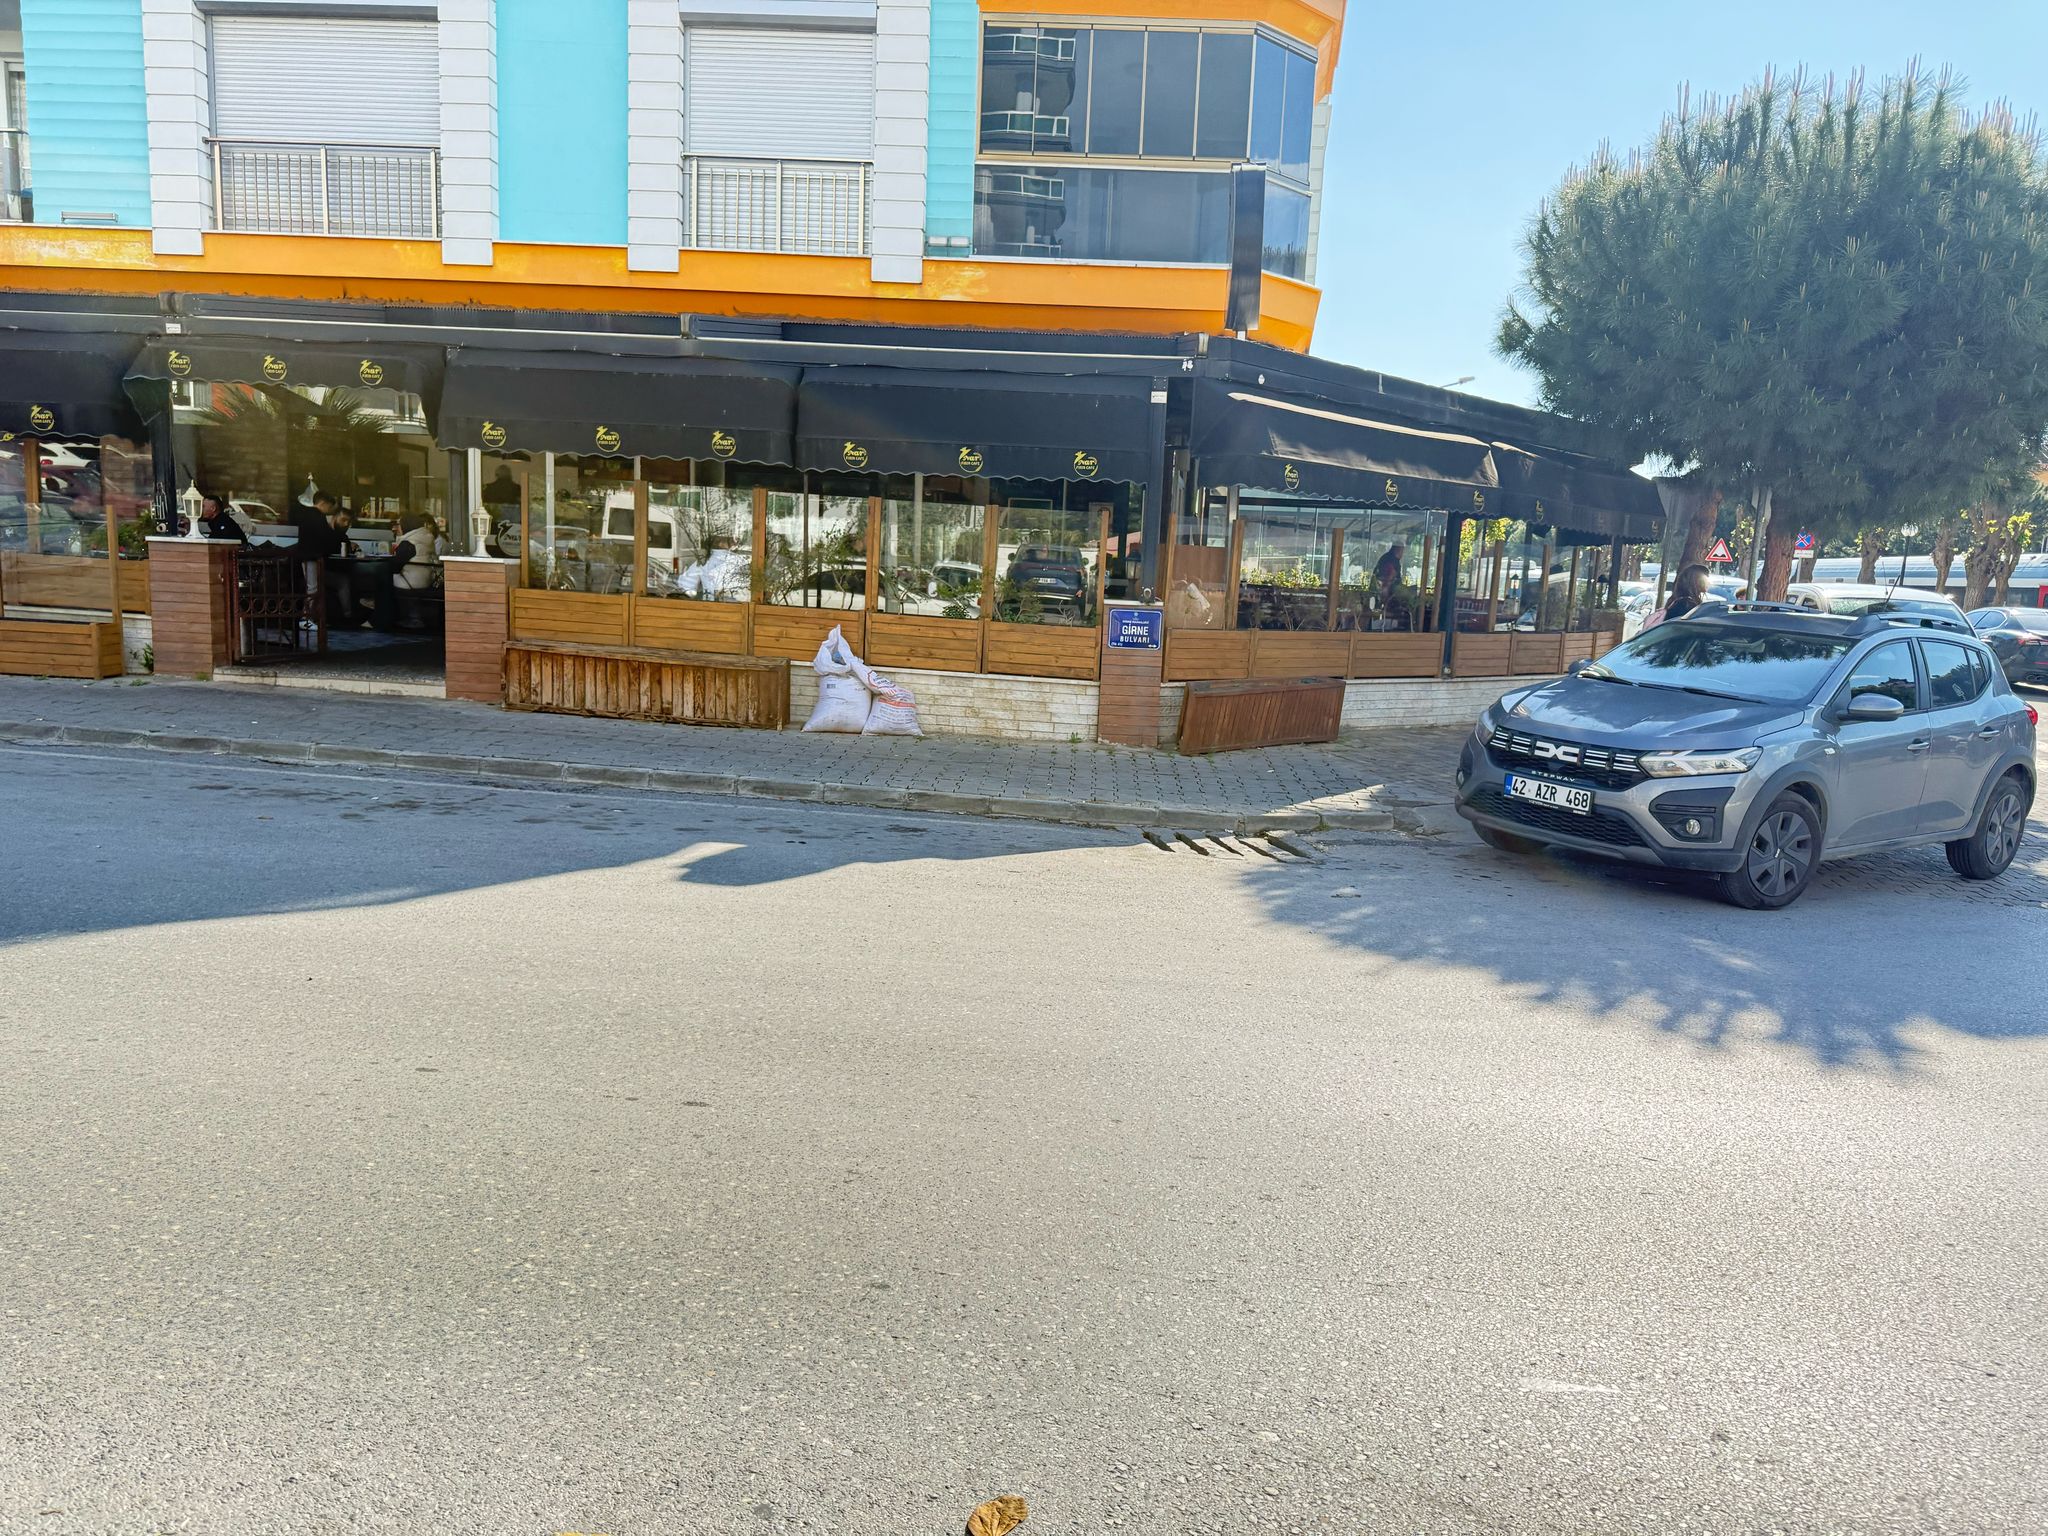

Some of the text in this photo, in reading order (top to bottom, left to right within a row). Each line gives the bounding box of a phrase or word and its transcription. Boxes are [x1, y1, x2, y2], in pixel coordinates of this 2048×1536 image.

[1122, 624, 1149, 635] GİRNE
[1531, 770, 1575, 782] STEPWAY
[1511, 778, 1527, 796] 42
[1535, 783, 1557, 802] AZR
[1565, 790, 1589, 809] 468
